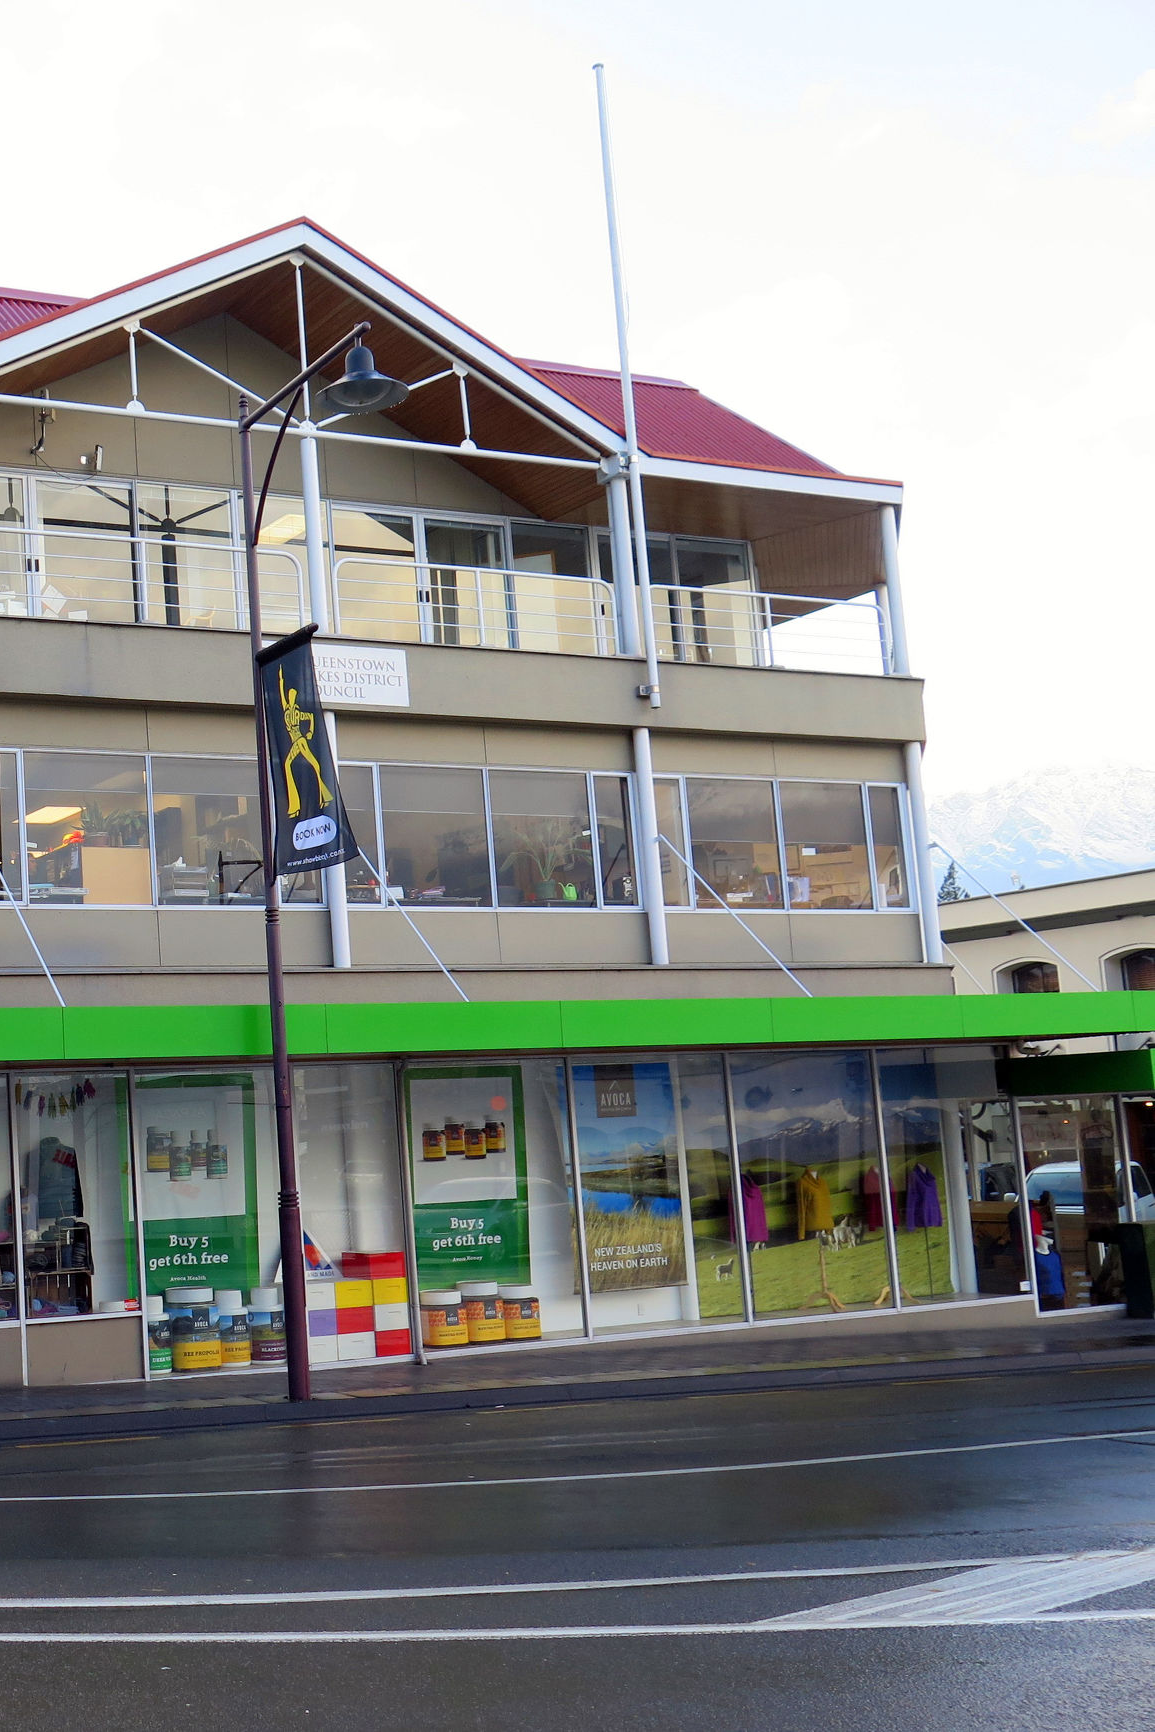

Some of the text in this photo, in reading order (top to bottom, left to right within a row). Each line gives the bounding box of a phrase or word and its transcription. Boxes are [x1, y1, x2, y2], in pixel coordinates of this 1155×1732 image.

[314, 656, 395, 672] UEENSTOWN
[318, 670, 403, 687] KES DISTRICT
[317, 685, 366, 698] OUNCIL
[295, 822, 331, 842] BOOK NOW
[601, 1092, 631, 1106] AVOCA
[450, 1217, 484, 1230] Buy 5
[169, 1235, 209, 1249] Buy 5
[432, 1233, 502, 1251] get 6th free
[594, 1243, 662, 1257] NEW ZEALAND'S
[149, 1252, 229, 1271] get 6th free
[590, 1257, 668, 1271] HEAVEN ON EARTH
